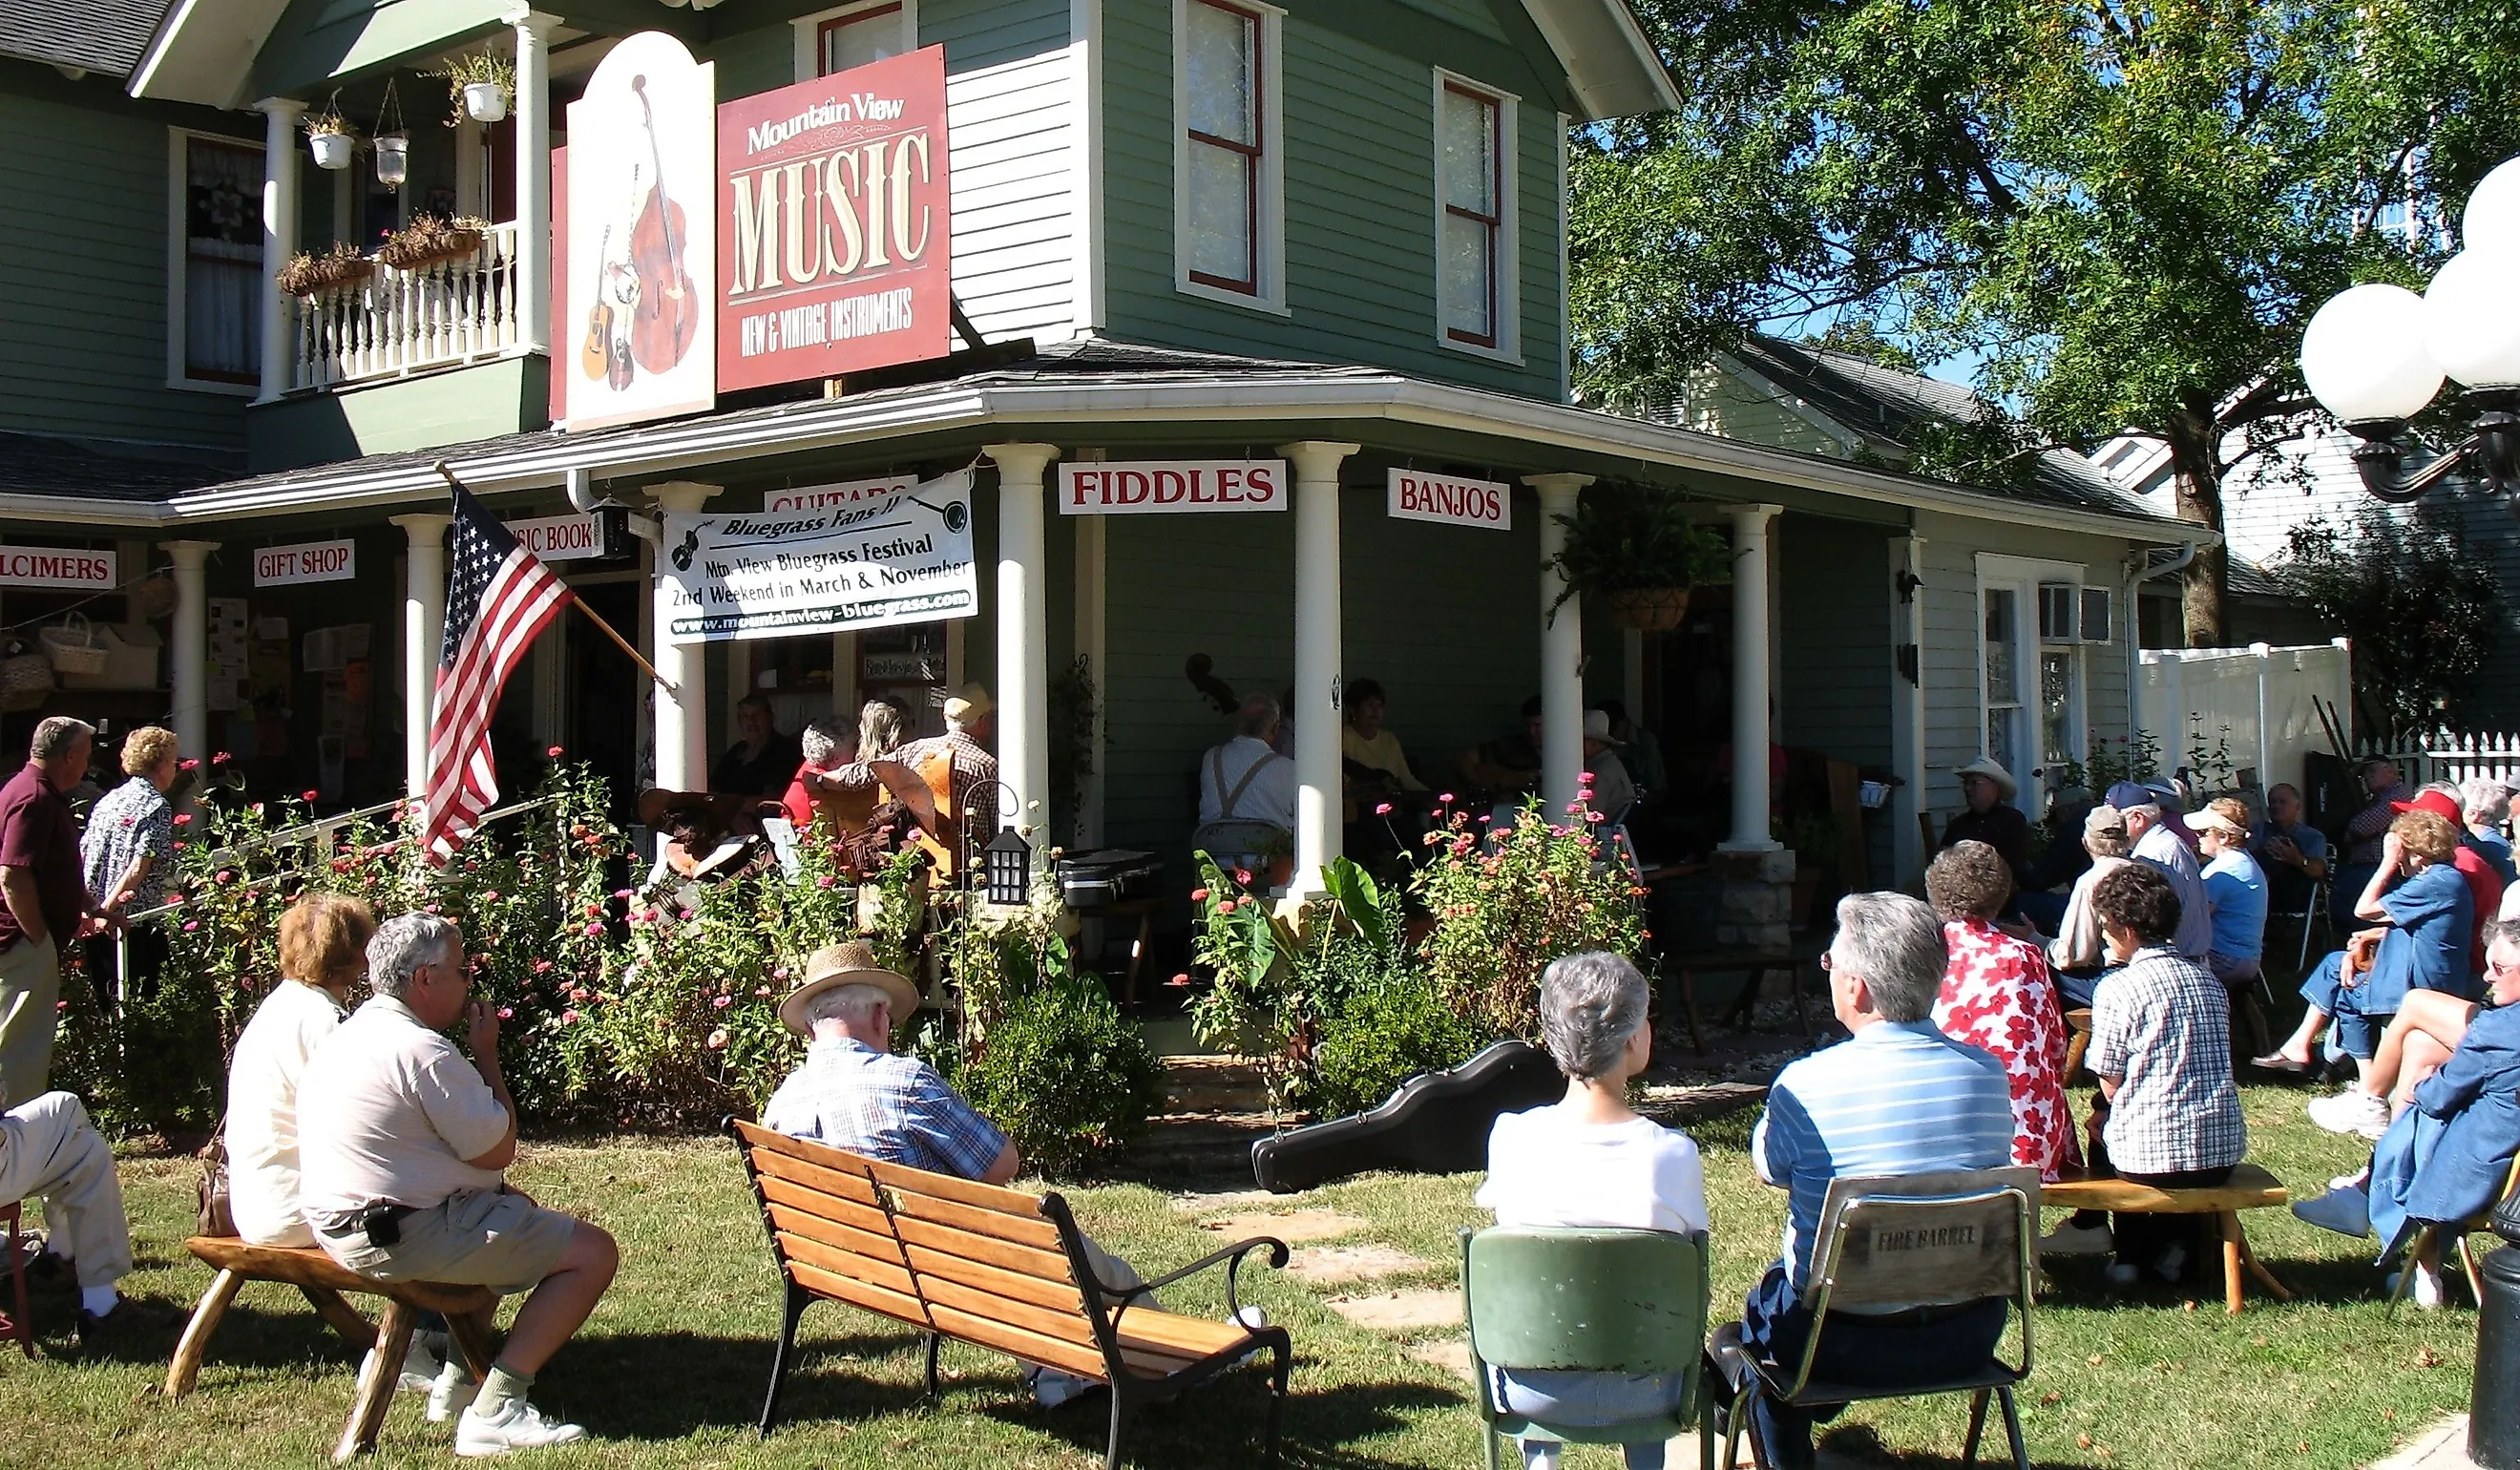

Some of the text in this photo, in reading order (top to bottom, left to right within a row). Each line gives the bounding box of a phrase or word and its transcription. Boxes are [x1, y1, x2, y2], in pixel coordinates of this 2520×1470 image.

[746, 93, 905, 156] Mountain View
[728, 132, 930, 296] MUSIC
[741, 286, 913, 357] NEW & VINTAGE INSTRUMENTS
[1071, 468, 1275, 505] FIDDLES
[1399, 477, 1502, 521] BANJOS
[514, 528, 541, 552] SIC
[723, 514, 827, 539] Bluegrass
[830, 506, 875, 529] Fans
[259, 547, 348, 578] GIFT SHOP
[737, 556, 772, 575] View
[776, 549, 858, 573] Bluegrass
[861, 534, 934, 561] Festival
[673, 559, 970, 606] 2nd Weekend in March & November
[673, 590, 971, 633] www.mountainview-bluegrass.com
[1879, 1225, 1975, 1252] FIRE BARREL
